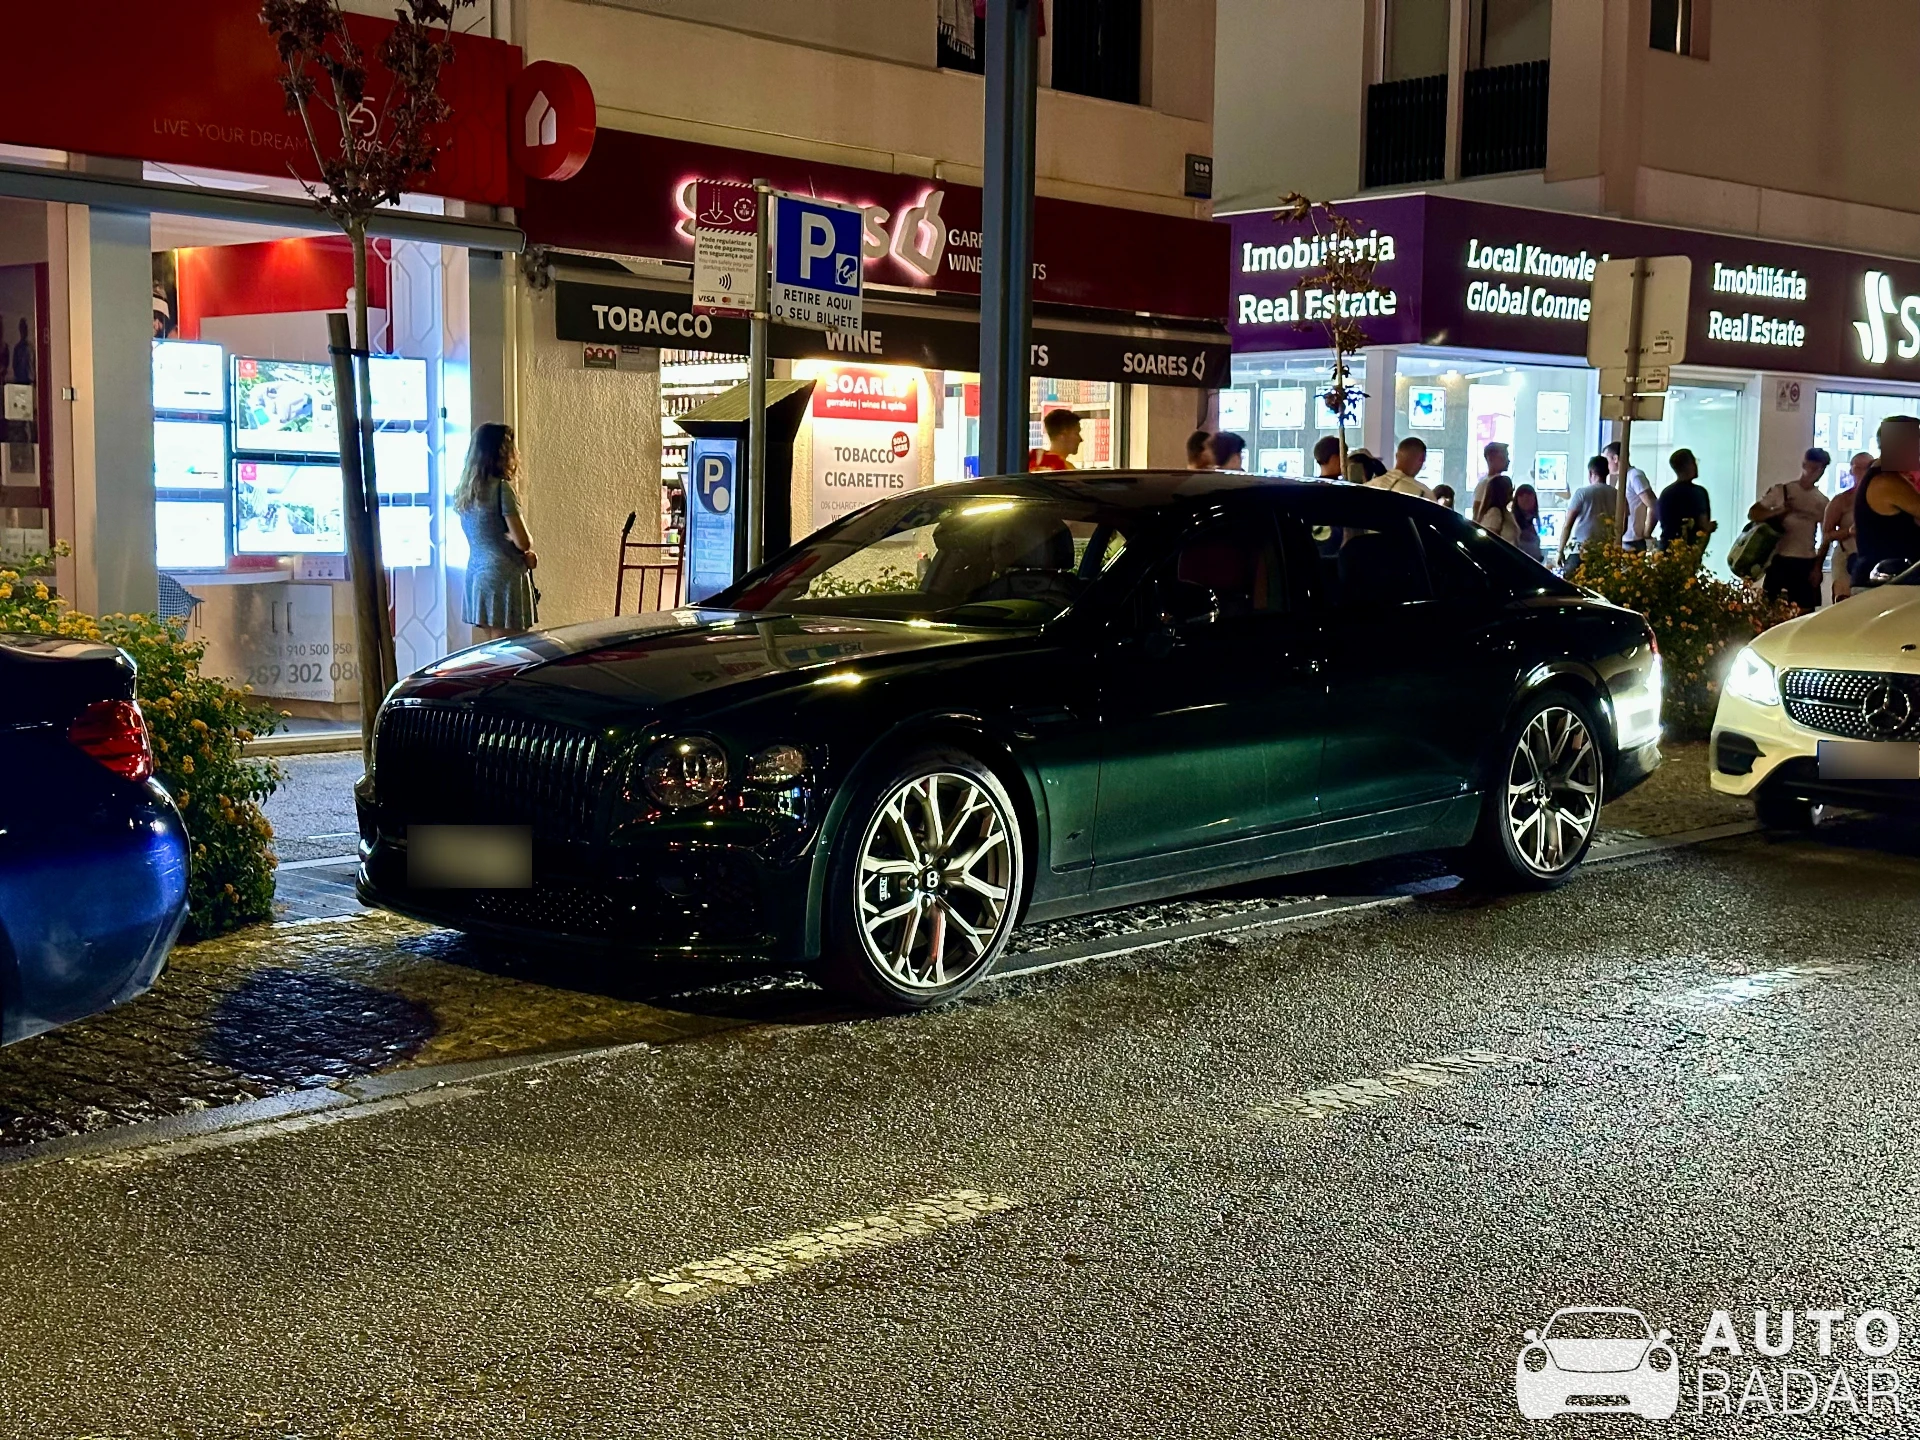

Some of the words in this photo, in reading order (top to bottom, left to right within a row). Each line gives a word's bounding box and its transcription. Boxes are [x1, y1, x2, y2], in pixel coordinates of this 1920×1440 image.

[153, 118, 190, 137] LIVE
[195, 122, 245, 143] YOUR
[251, 130, 309, 151] DREAM
[717, 238, 747, 246] regularizar
[800, 211, 836, 280] P
[709, 251, 738, 259] segurança
[1467, 239, 1523, 274] Local
[1713, 262, 1807, 301] Imobiliária
[698, 295, 716, 303] VISA
[783, 288, 821, 306] RETIRE
[826, 296, 852, 311] AQUI
[1238, 289, 1299, 325] Real
[1304, 289, 1397, 320] Estate
[1466, 281, 1531, 316] Global
[591, 304, 712, 339] TOBACCO
[775, 304, 783, 317] O
[789, 307, 811, 322] SEU
[816, 311, 858, 329] BILHETE
[1708, 310, 1748, 343] Real
[1750, 314, 1805, 348] Estate
[825, 330, 883, 355] WINE
[1122, 352, 1188, 377] SOARES
[834, 446, 895, 464] TOBACCO
[703, 458, 724, 495] P
[824, 471, 904, 489] CIGARETTES
[286, 644, 306, 656] 910
[310, 643, 330, 656] 500
[333, 642, 352, 655] 950
[246, 664, 282, 685] 289
[288, 662, 323, 684] 302
